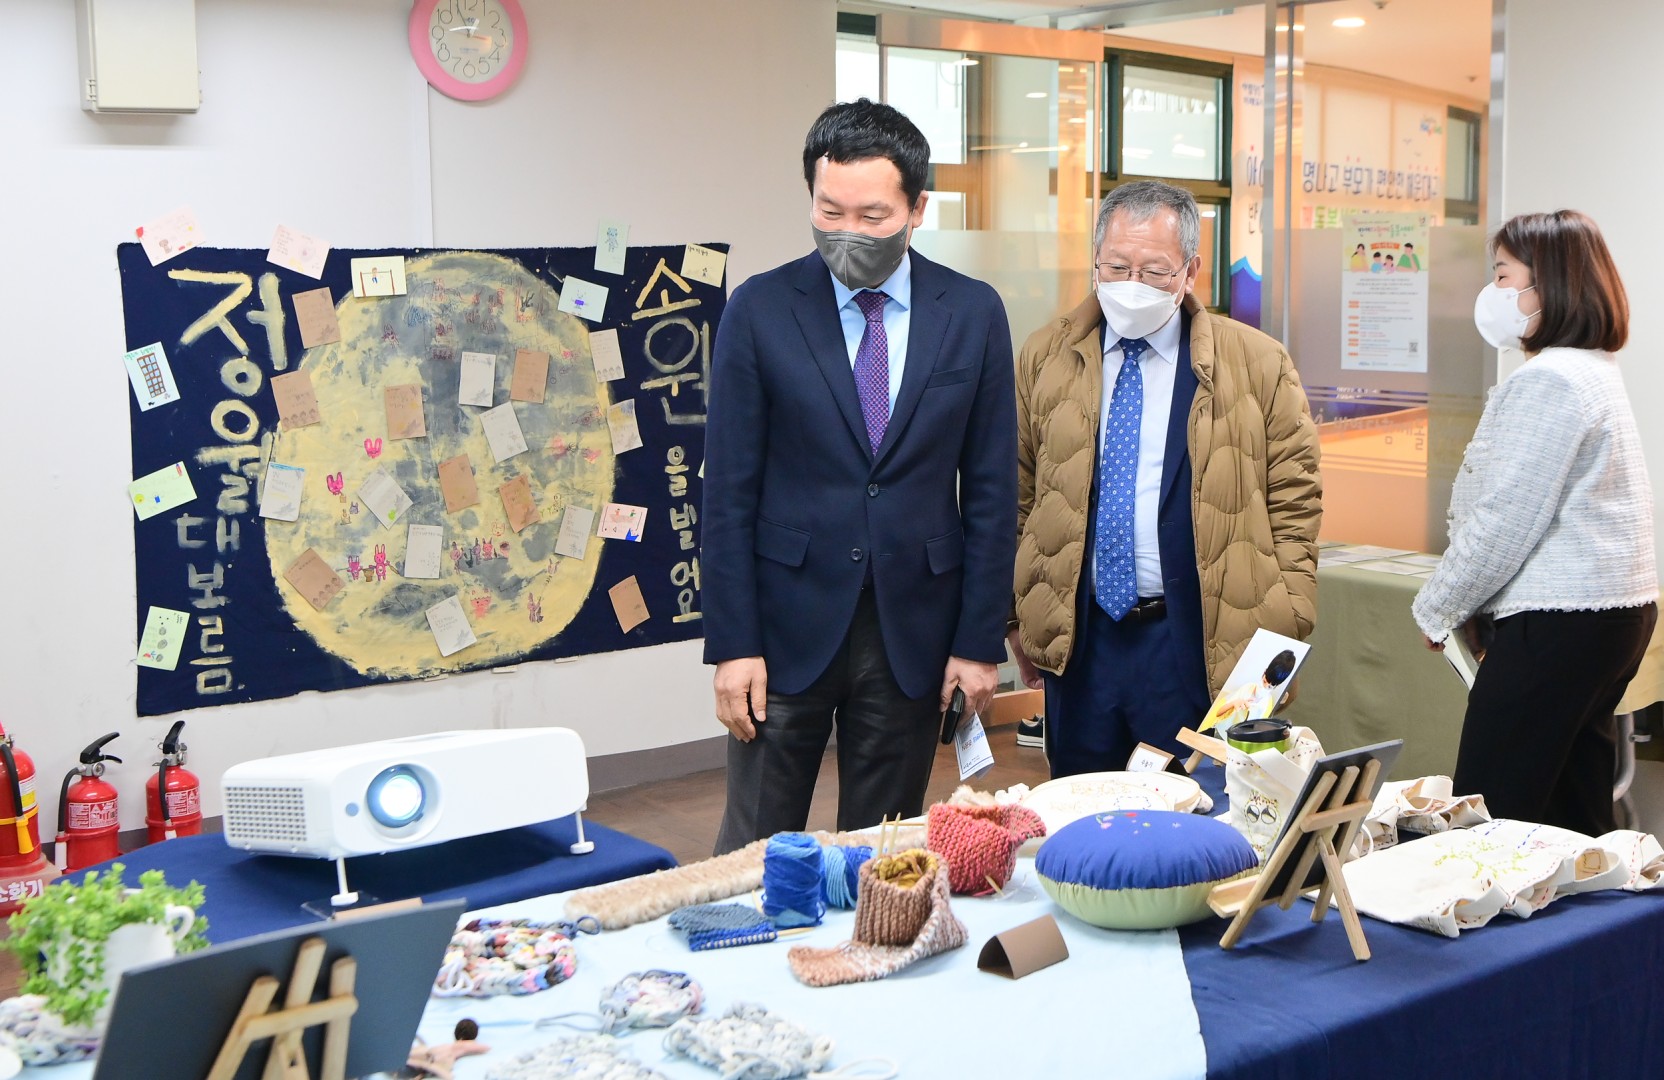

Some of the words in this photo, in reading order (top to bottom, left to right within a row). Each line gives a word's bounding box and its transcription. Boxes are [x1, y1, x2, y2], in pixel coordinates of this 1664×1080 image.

[437, 8, 453, 24] 10
[488, 10, 501, 28] 2
[431, 25, 444, 45] 9
[494, 28, 507, 48] 3
[437, 42, 450, 62] 8
[488, 47, 501, 63] 4
[451, 56, 462, 73] 7
[463, 60, 476, 78] 6
[478, 56, 491, 75] 5
